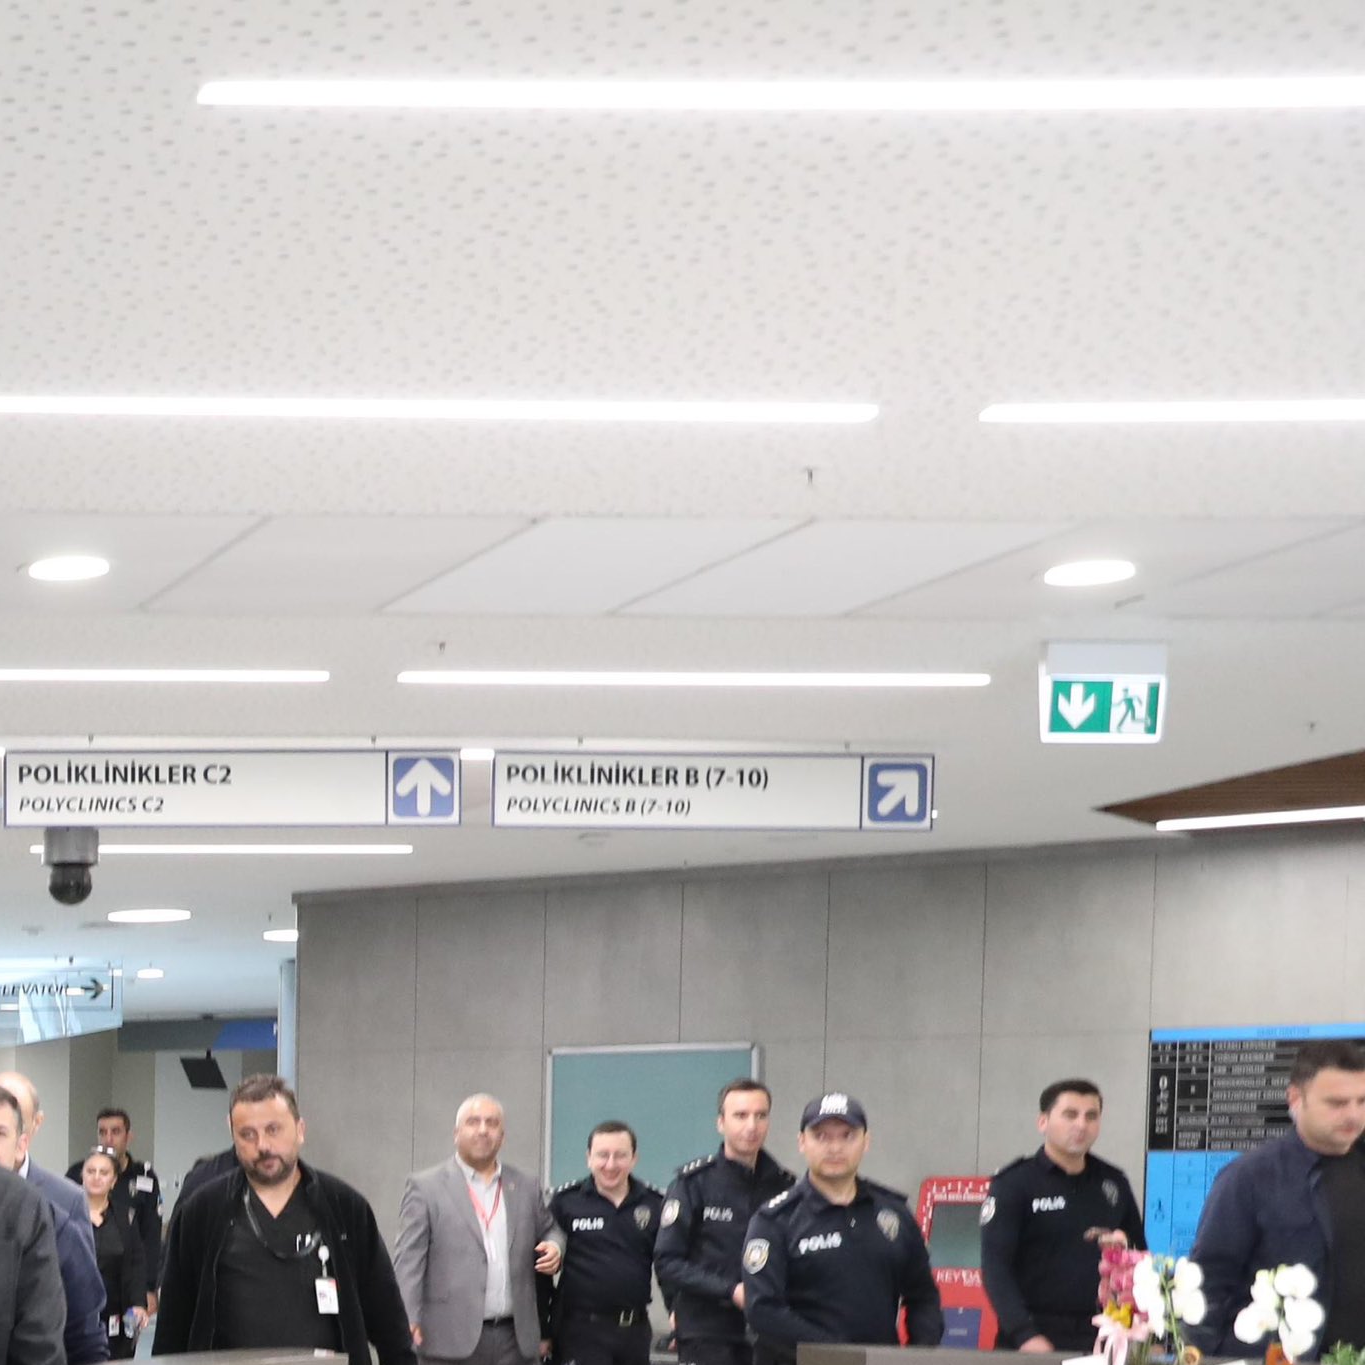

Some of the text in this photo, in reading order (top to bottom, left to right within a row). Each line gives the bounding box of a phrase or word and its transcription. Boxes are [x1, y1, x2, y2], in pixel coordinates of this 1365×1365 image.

[18, 758, 231, 785] POLİKLİNİKLER C2
[506, 760, 769, 791] POLİKLİNİKLER B (7-10)
[19, 797, 164, 813] POLYCLINICS C2
[507, 797, 691, 817] POLYCLINICS B (7-10)
